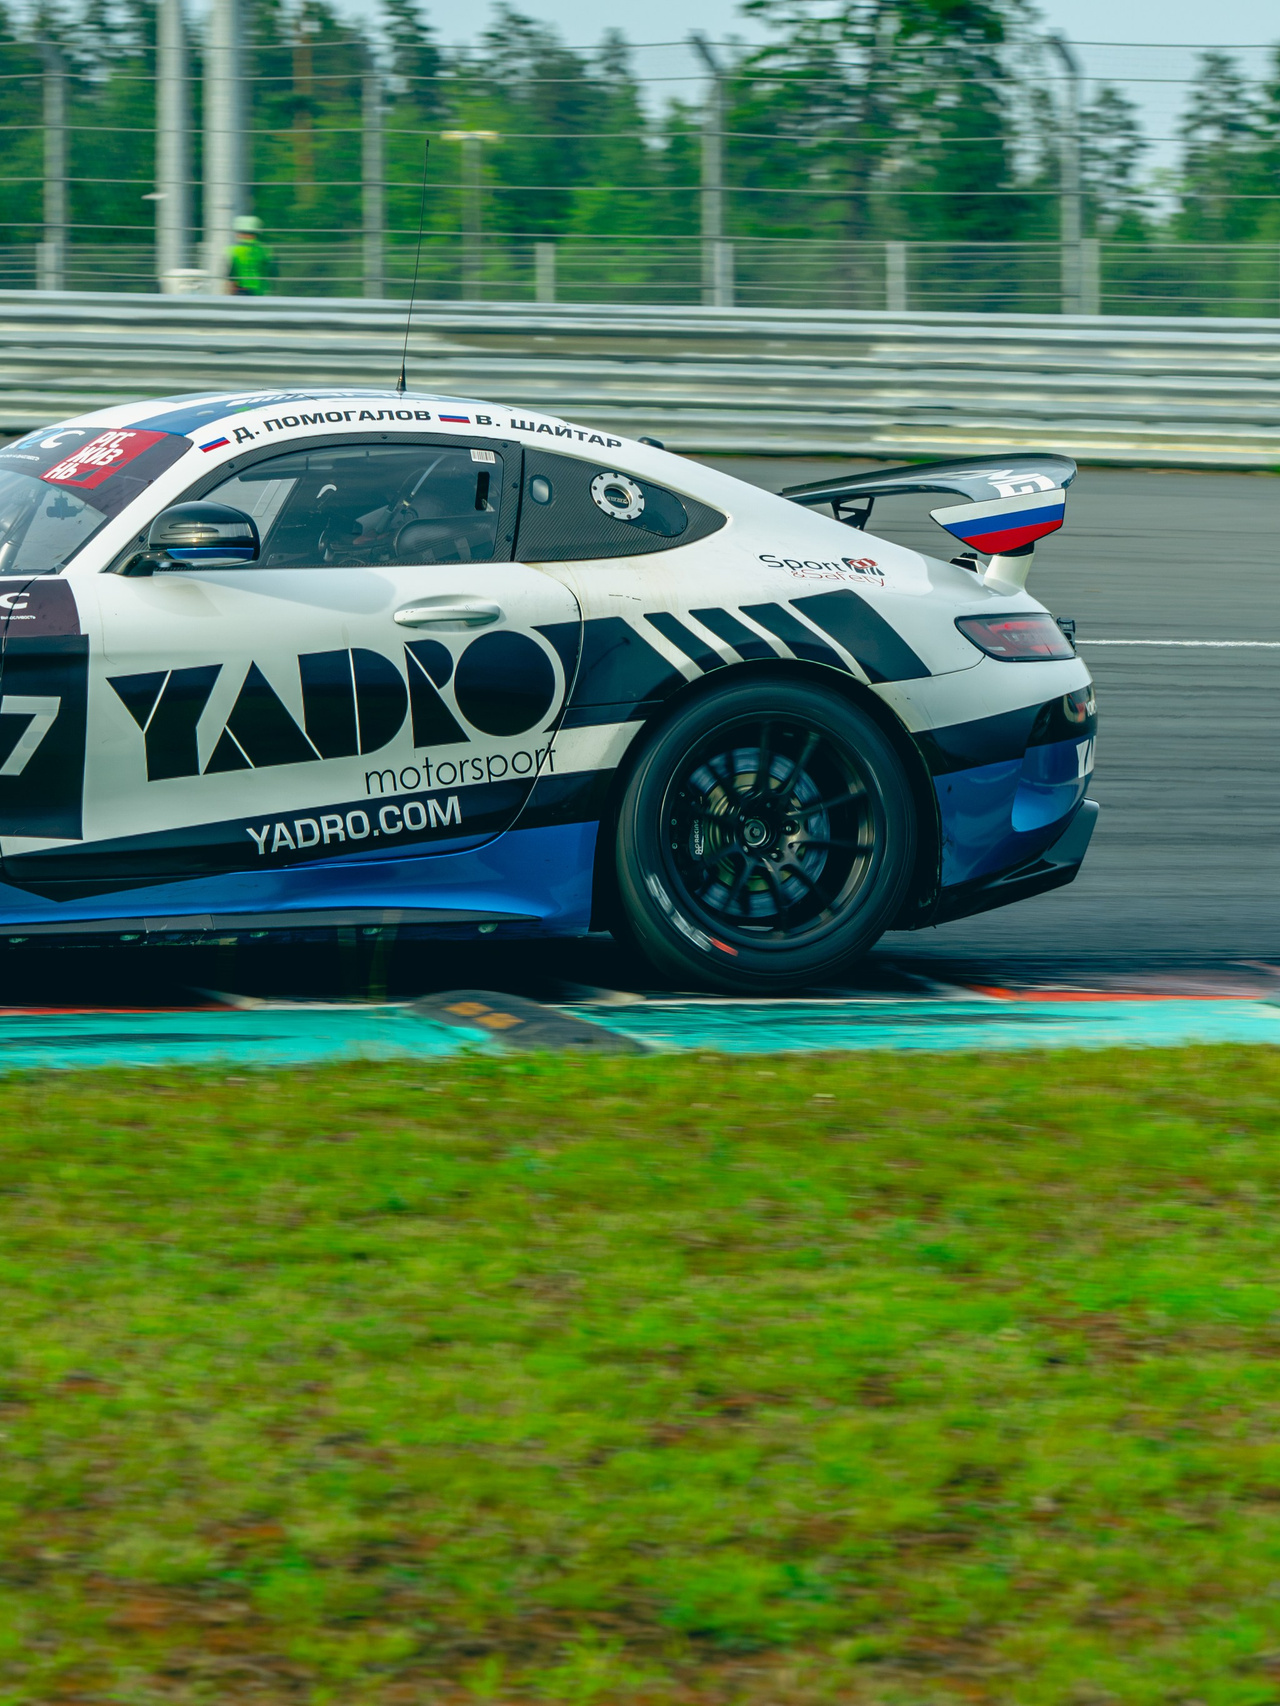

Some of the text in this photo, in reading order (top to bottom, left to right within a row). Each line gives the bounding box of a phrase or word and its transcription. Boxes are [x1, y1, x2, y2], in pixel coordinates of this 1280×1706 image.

[232, 410, 432, 444] Д. ПОМОГАЛОВ
[475, 414, 622, 448] В. ШАЙТАР
[44, 462, 80, 480] НЬ
[67, 446, 123, 466] ЖИЗ
[758, 554, 847, 573] Sport
[106, 629, 557, 782] YADRO
[364, 743, 556, 795] motorsport
[246, 795, 463, 855] YADRO.COM
